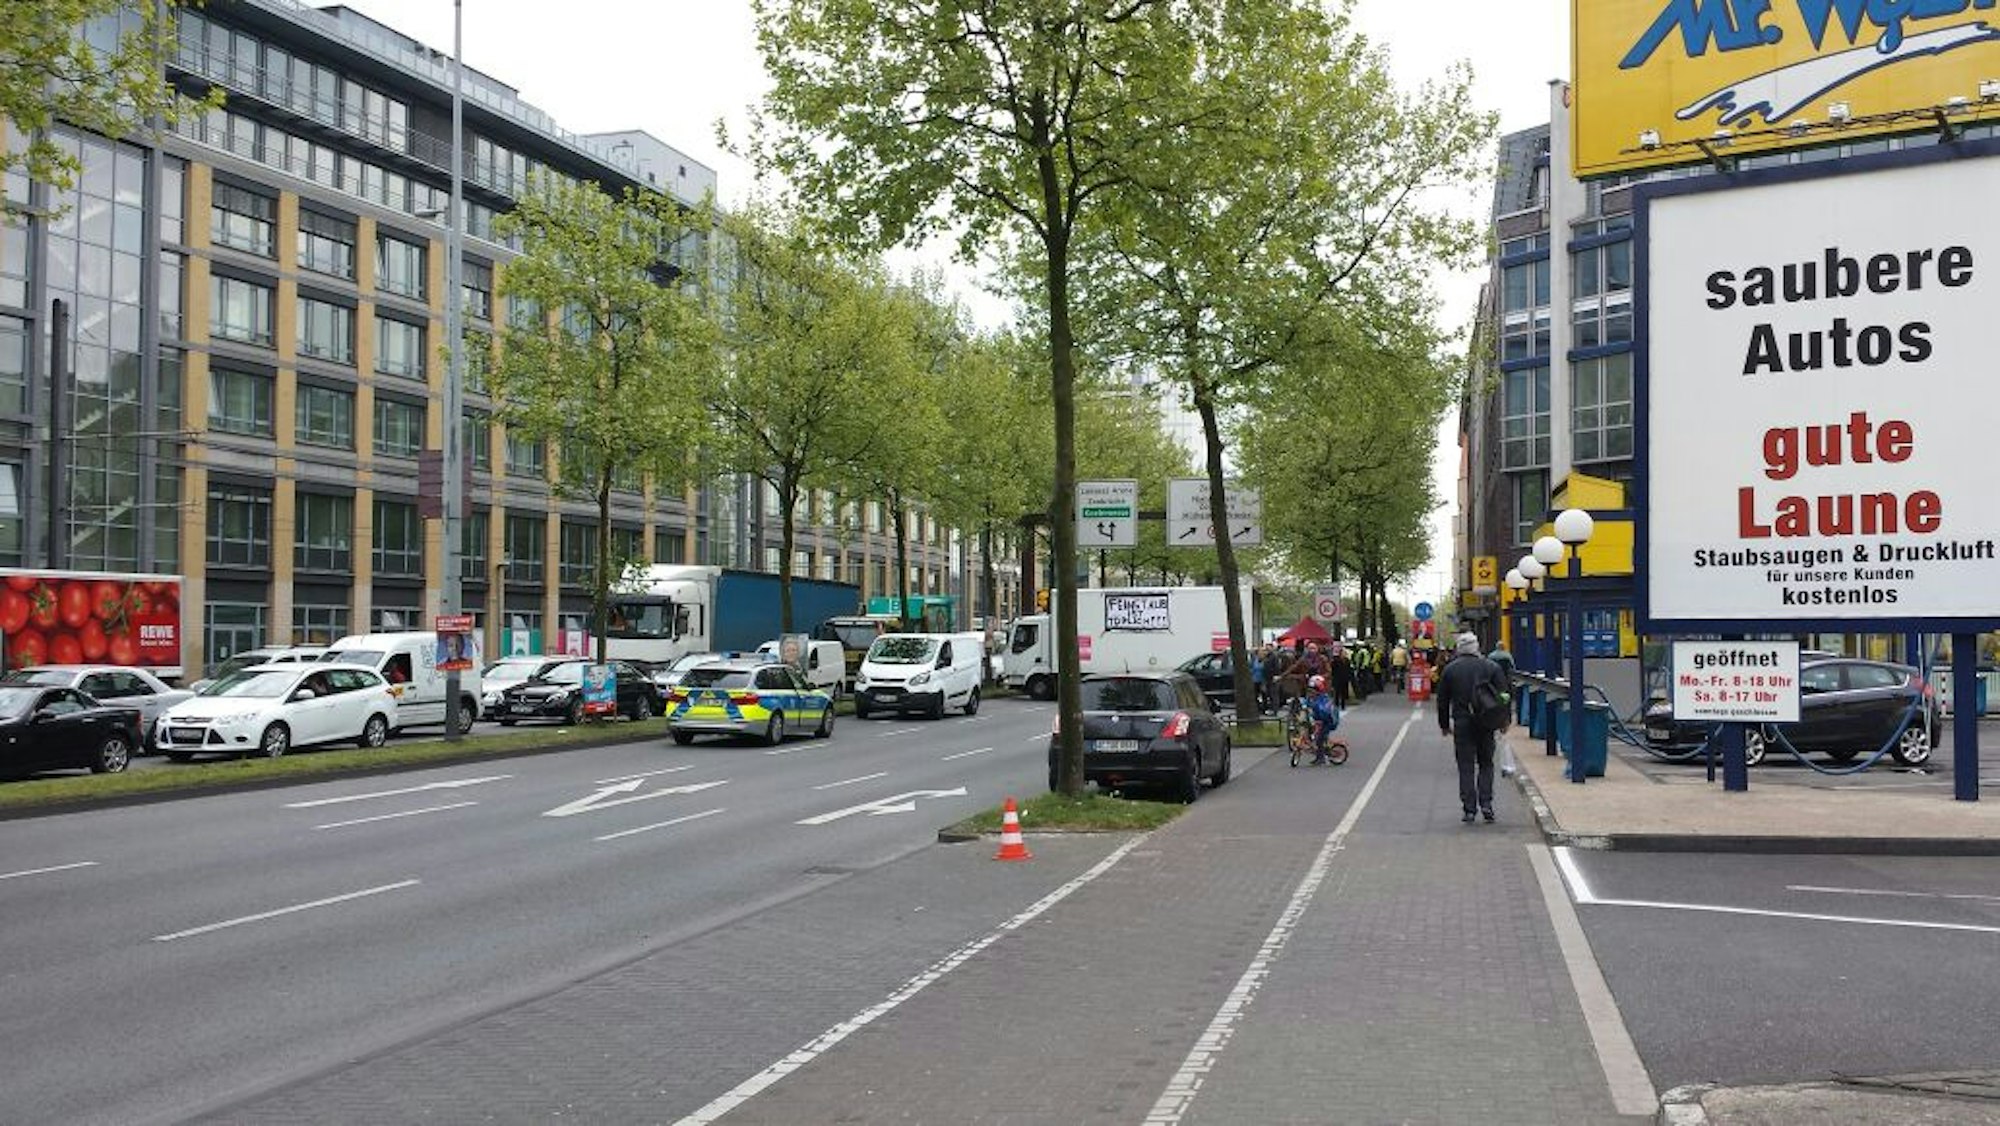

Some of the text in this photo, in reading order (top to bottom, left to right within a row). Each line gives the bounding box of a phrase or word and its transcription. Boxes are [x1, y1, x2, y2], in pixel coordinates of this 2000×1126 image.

[1617, 0, 1783, 69] Mr.
[1705, 246, 1973, 310] saubere
[1742, 317, 1933, 375] Autos
[1762, 411, 1914, 481] gute
[1738, 486, 1942, 539] Laune
[1693, 540, 1995, 568] Staubsaugen & Druckluft
[1766, 567, 1914, 583] für unsere Kunden
[1782, 584, 1898, 606] kostenlos
[140, 625, 174, 638] REWE
[1693, 649, 1778, 669] geöffnet
[1680, 674, 1728, 687] Mo.-Fr.
[1768, 675, 1792, 687] Uhr
[1694, 690, 1778, 702] Sa. 8-17 Uhr
